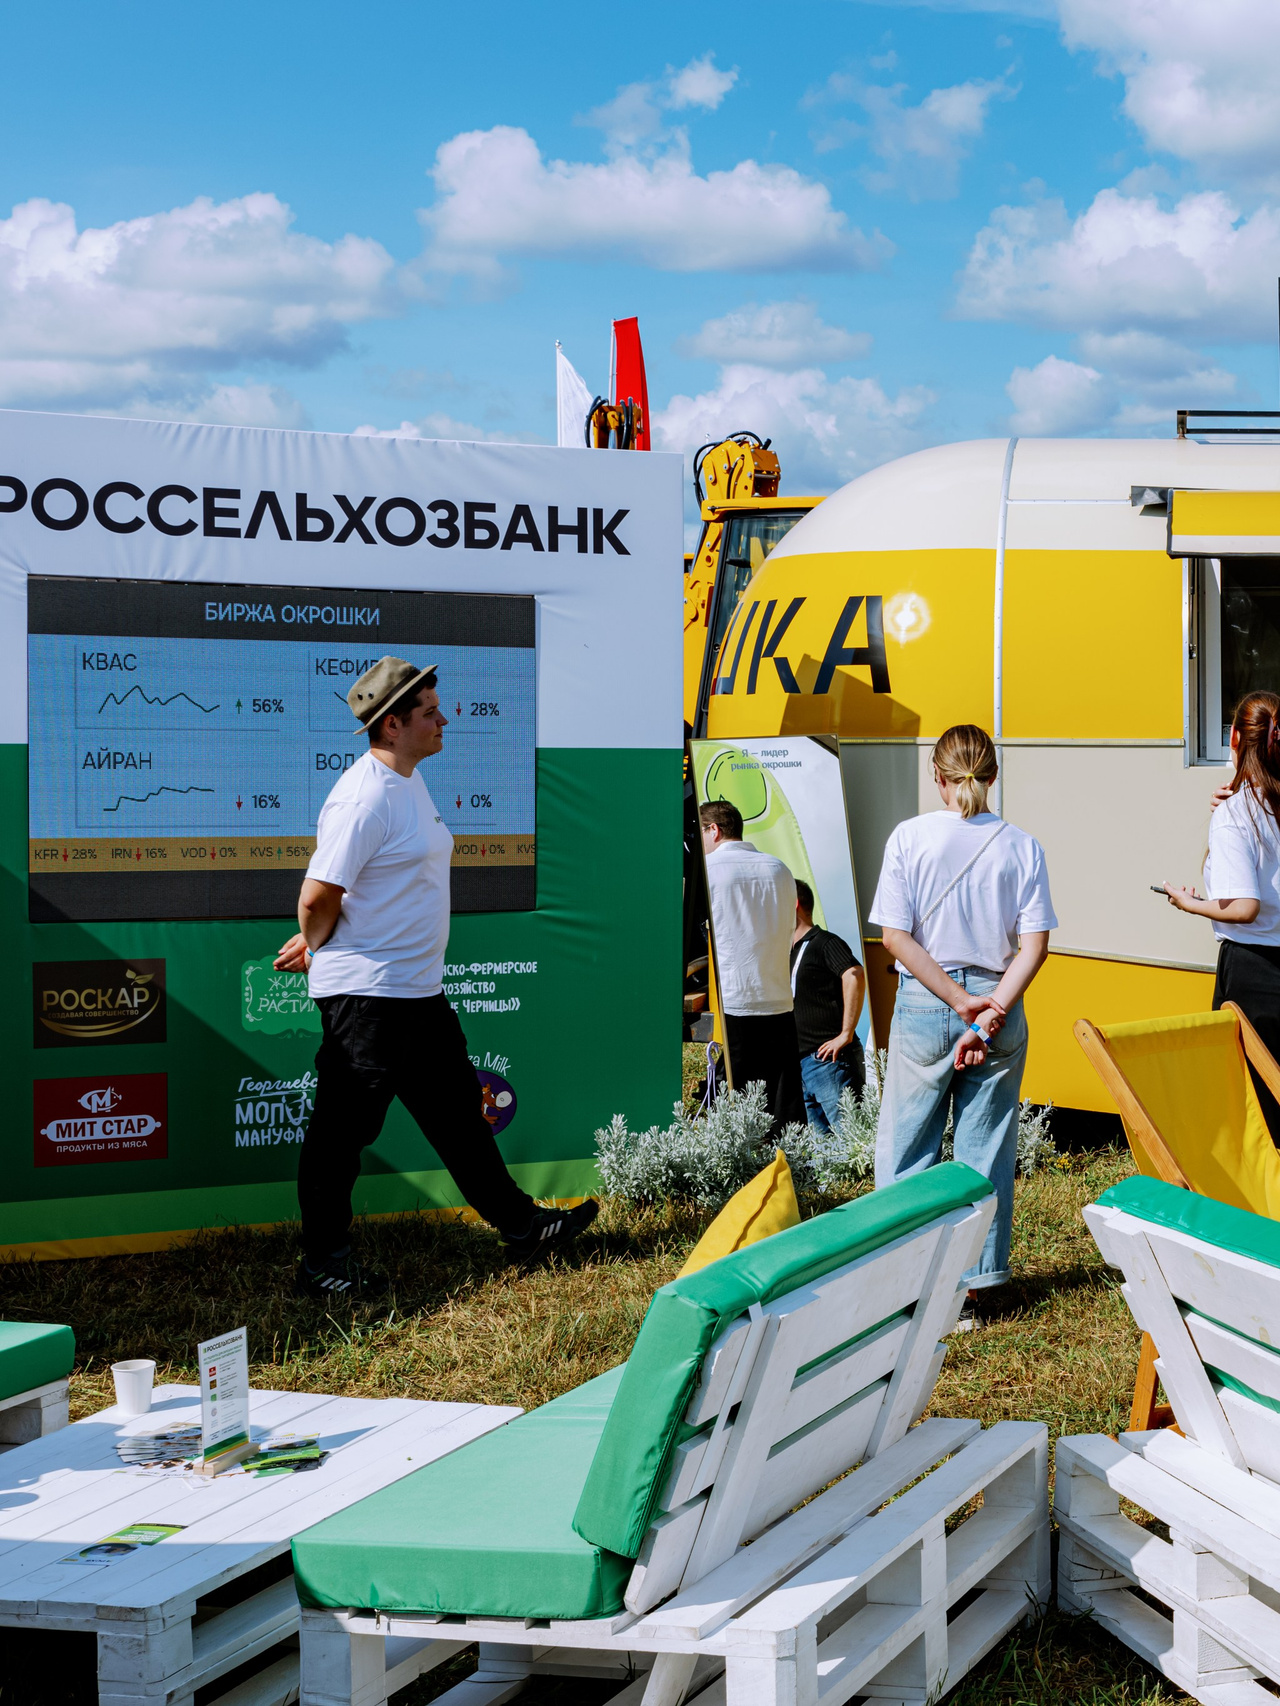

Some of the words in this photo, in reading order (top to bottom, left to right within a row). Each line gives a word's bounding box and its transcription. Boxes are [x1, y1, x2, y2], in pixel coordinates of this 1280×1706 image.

[0, 475, 632, 556] РОССЕЛЬХОЗБАНК
[205, 602, 276, 623] БИРЖА
[281, 604, 380, 627] ОКРОШКИ
[82, 652, 138, 671] КВАС
[252, 698, 285, 713] 56%
[470, 702, 500, 717] 28%
[82, 747, 152, 770] АЙРАН
[741, 749, 748, 758] Я
[761, 749, 789, 758] лидер
[316, 753, 364, 774] ВОД
[731, 763, 760, 772] рынка
[762, 761, 802, 770] окрошки
[251, 794, 281, 809] 16%
[470, 794, 492, 808] 0%
[34, 849, 59, 860] KFR
[72, 848, 97, 860] 28%
[111, 848, 132, 860] IRN
[145, 848, 167, 859] 16%
[181, 847, 207, 859] VOD
[219, 847, 238, 858] 0%
[250, 847, 274, 858] KVS
[286, 846, 311, 857] 56%
[454, 844, 477, 855] VOD
[489, 844, 506, 855] 0%
[442, 961, 538, 977] НСКО-ФЕРМЕРСКОЕ
[267, 974, 308, 991] ЖИЛ
[42, 987, 150, 1012] РОСКАР
[84, 1009, 139, 1018] СОВЕРШЕНСТВО
[483, 1052, 512, 1076] Milk
[238, 1071, 318, 1096] Георгиевс
[55, 1121, 97, 1139] МИТ
[101, 1118, 149, 1136] СТАР
[235, 1126, 308, 1147] МАНУФА
[56, 1143, 105, 1153] ПРОДУКТЫ
[122, 1140, 148, 1149] МЯСА
